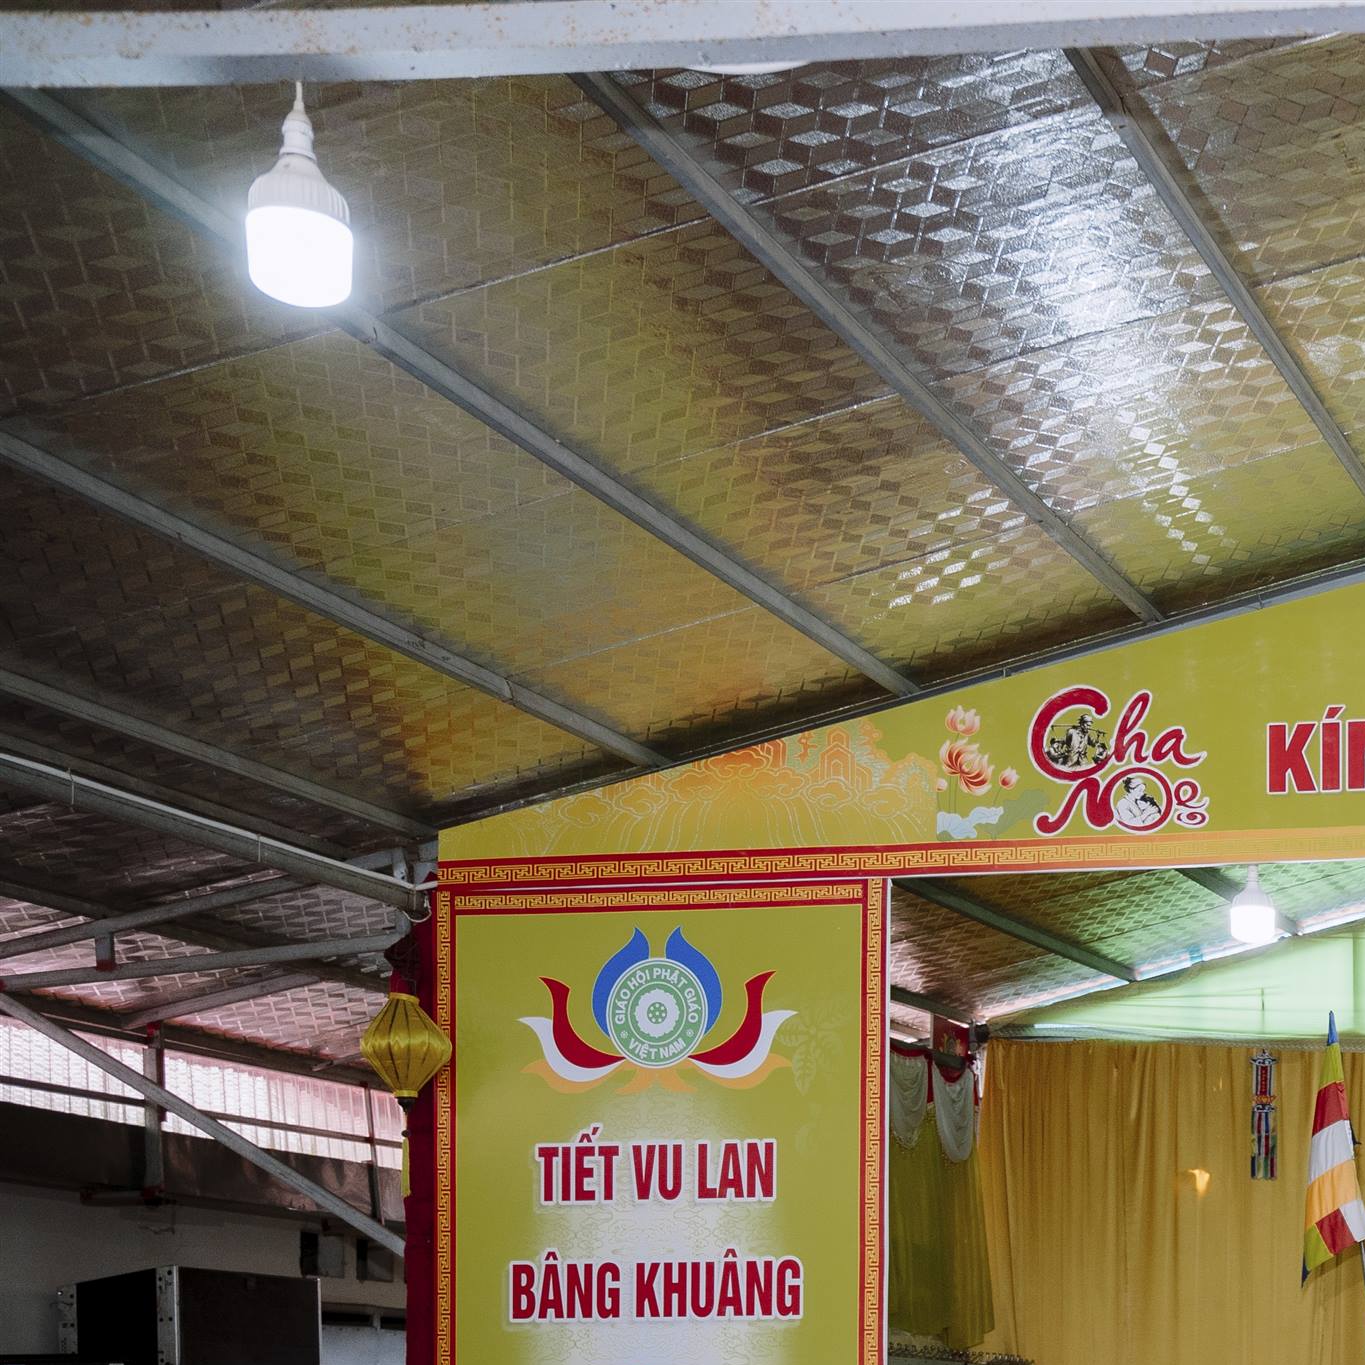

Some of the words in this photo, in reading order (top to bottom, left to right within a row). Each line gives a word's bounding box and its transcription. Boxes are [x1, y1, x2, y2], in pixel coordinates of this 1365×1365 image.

[1030, 687, 1204, 781] Cha
[615, 989, 631, 1025] GIÁO
[628, 969, 650, 990] HỘI
[653, 967, 688, 988] PHẬT
[684, 987, 701, 1023] GIÁO
[629, 1038, 659, 1060] VIỆT
[660, 1038, 686, 1058] NAM
[537, 1126, 619, 1202] TIẾT
[632, 1143, 682, 1200] VU
[697, 1141, 775, 1199] LAN
[511, 1250, 621, 1320] BÂNG
[635, 1248, 801, 1318] KHUÂNG
